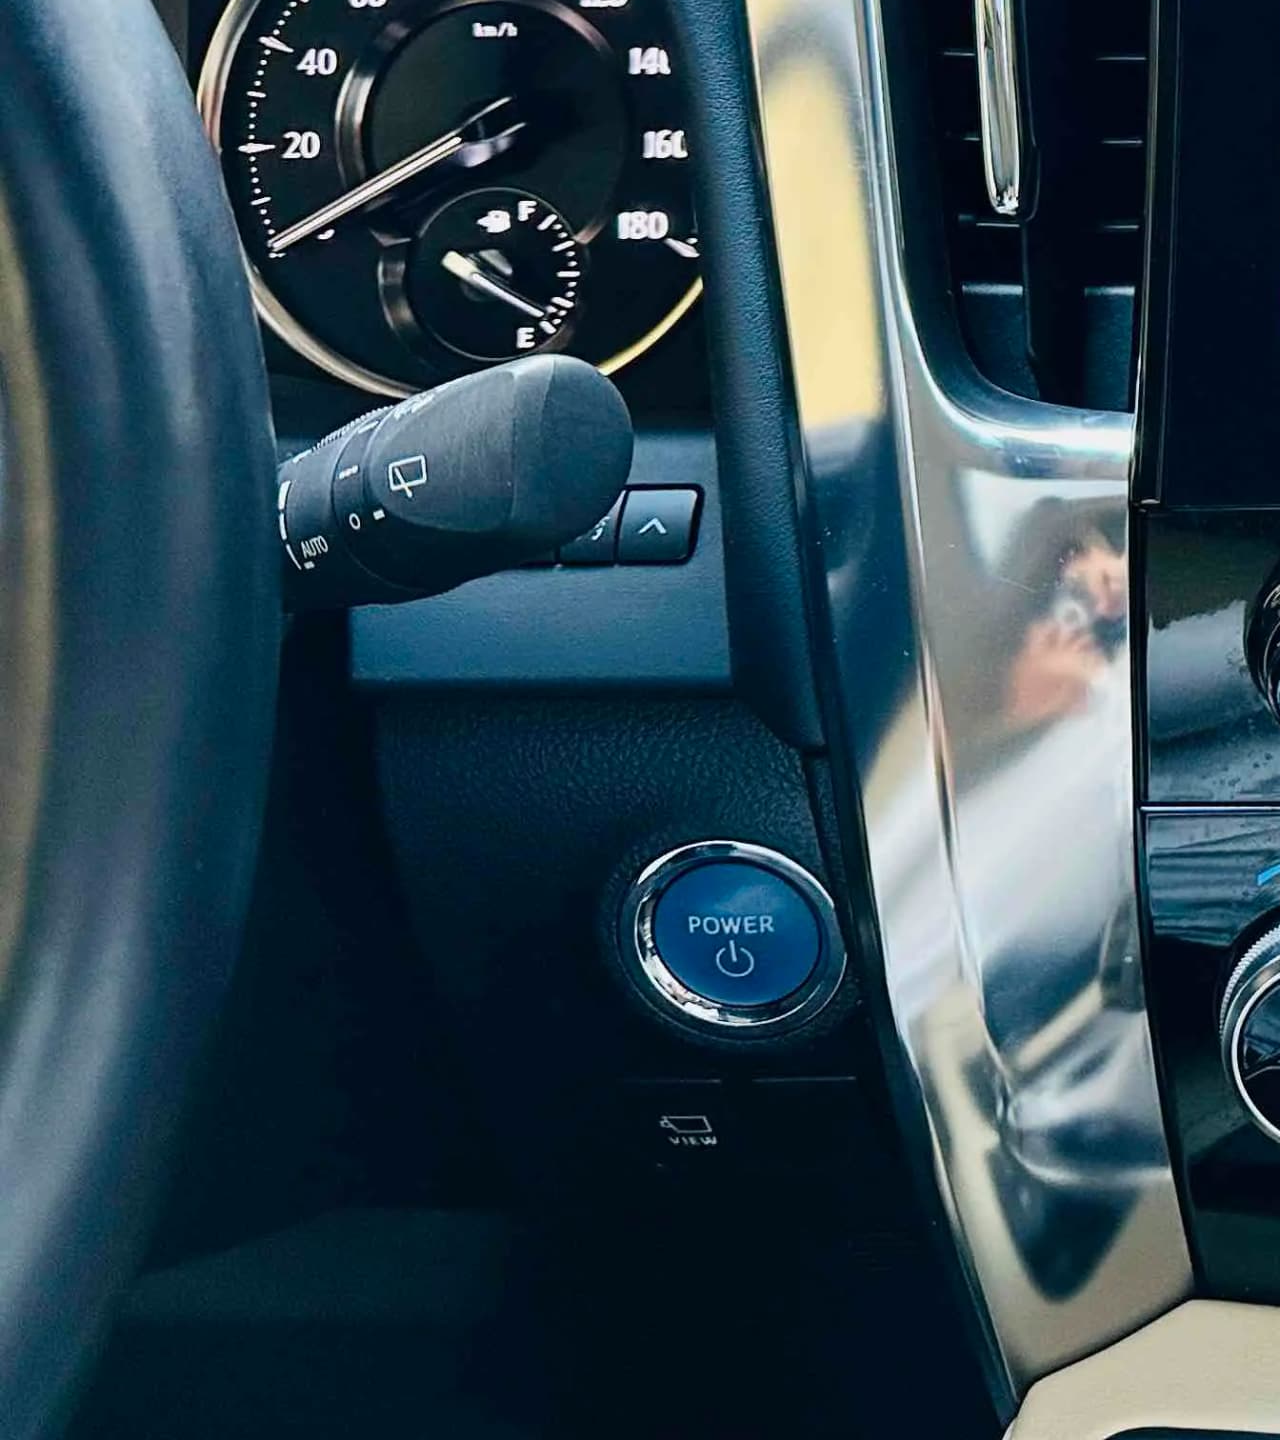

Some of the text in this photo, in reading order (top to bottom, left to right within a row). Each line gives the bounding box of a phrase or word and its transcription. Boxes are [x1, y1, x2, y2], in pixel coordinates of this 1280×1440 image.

[297, 48, 338, 75] 40
[282, 131, 321, 159] 20
[518, 200, 537, 221] F
[617, 211, 669, 240] 180
[516, 327, 536, 348] E
[300, 534, 329, 559] AUTO
[688, 915, 775, 935] POWER
